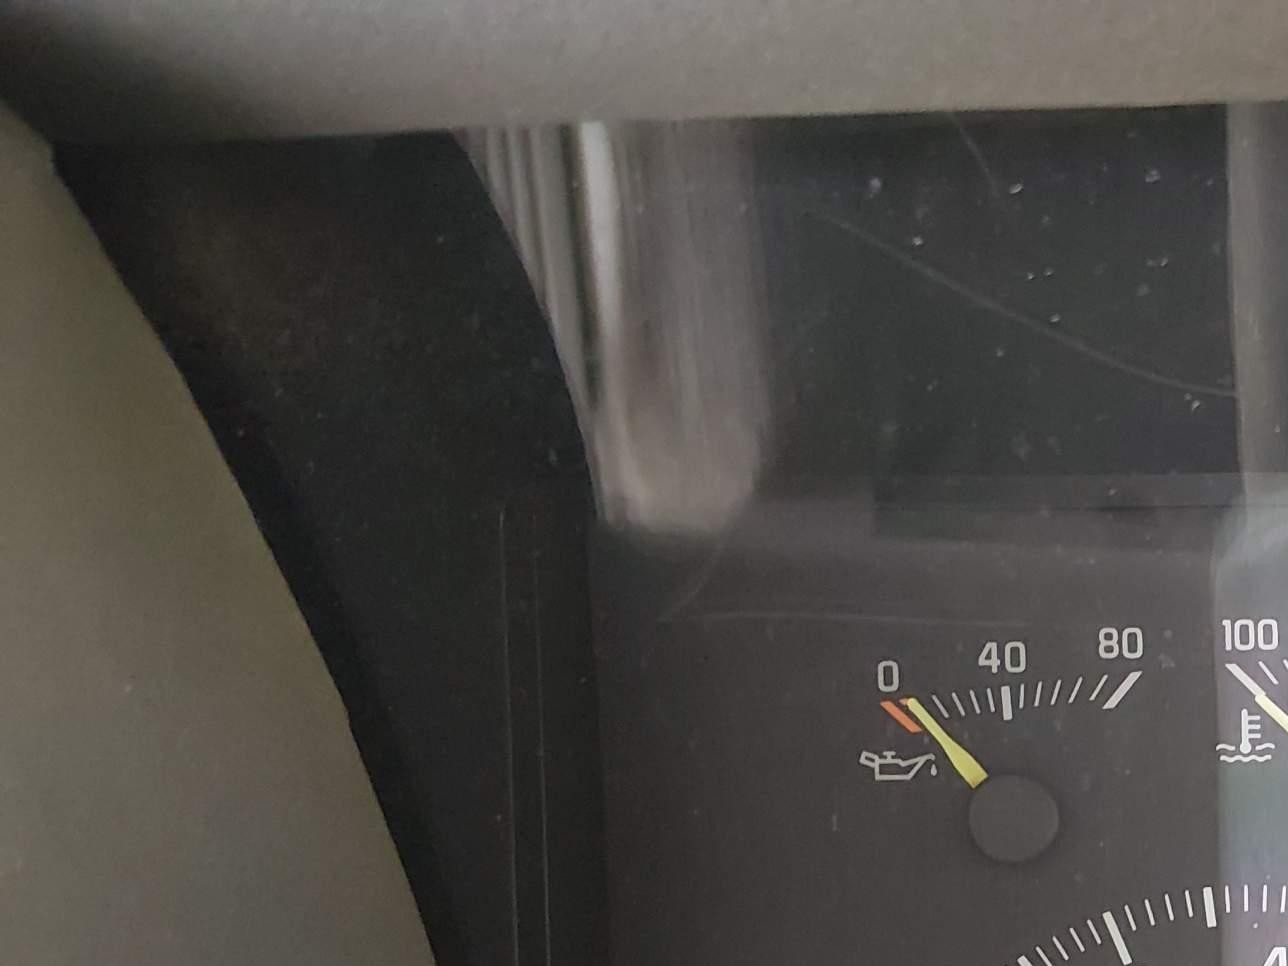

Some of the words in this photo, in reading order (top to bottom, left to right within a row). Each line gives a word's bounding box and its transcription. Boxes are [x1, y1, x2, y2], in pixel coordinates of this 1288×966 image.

[1098, 627, 1144, 659] 80
[1222, 618, 1279, 651] 100
[978, 641, 1027, 674] 40
[877, 660, 900, 693] 0
